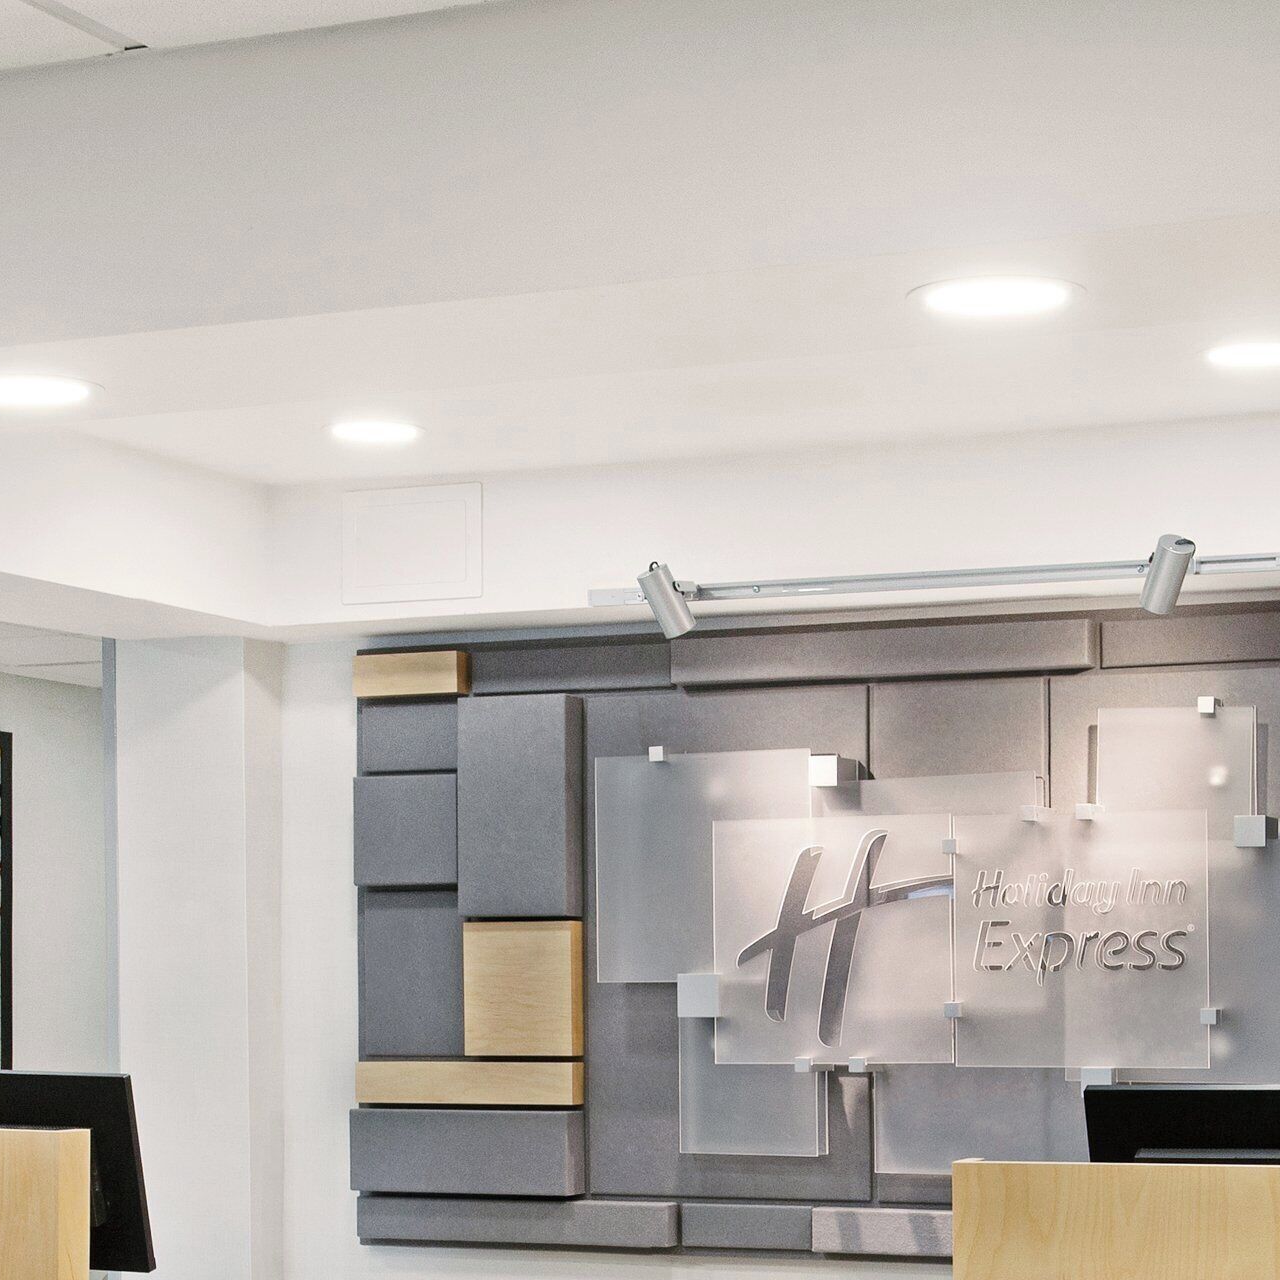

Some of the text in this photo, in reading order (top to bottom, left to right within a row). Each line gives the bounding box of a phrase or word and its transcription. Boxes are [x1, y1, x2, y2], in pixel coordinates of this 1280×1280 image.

[972, 867, 1188, 916] Holiday Inn
[973, 920, 1188, 986] Express
